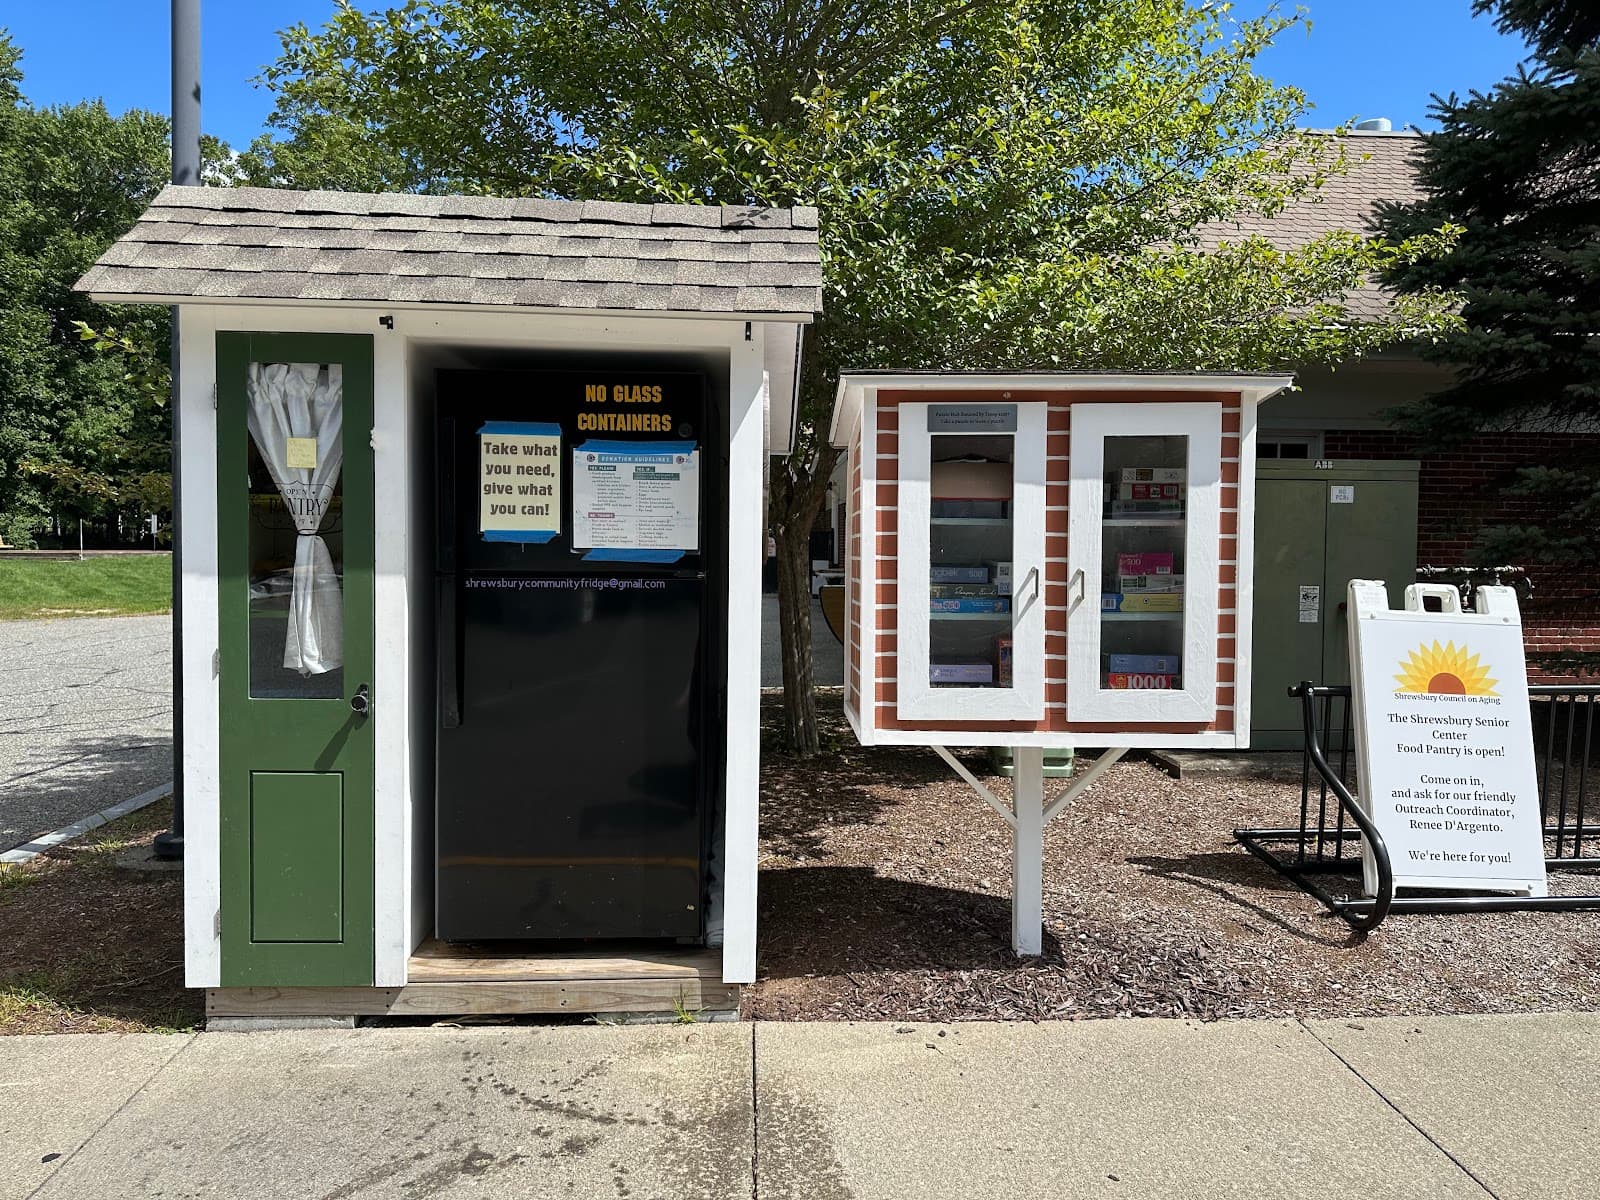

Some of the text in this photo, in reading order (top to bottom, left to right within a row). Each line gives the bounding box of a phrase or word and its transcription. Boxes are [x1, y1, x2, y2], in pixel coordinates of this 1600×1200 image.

[585, 384, 662, 403] NO GLASS
[577, 413, 672, 432] CONTAINERS
[483, 441, 558, 457] Take what
[485, 463, 555, 478] you need,
[1315, 460, 1333, 469] ABB
[483, 482, 553, 497] give what
[269, 497, 329, 516] PANTRY
[490, 503, 550, 516] you can!
[465, 577, 666, 591] shrewsburycommunityfridge@gmail.com
[1394, 692, 1438, 703] Shrewsbury
[1438, 694, 1466, 703] Council
[1478, 696, 1502, 706] Aging
[1387, 712, 1510, 728] The Shrewsbury Senior
[1432, 730, 1468, 741] Center
[1397, 743, 1505, 759] Food Pantry is open!
[1420, 774, 1485, 788] Come on in,
[1391, 788, 1516, 803] and ask for our friendly
[1395, 803, 1516, 819] Outreach Coordinator,
[1409, 819, 1503, 834] Renee D'Argento.
[1408, 850, 1512, 865] We're here for you!
